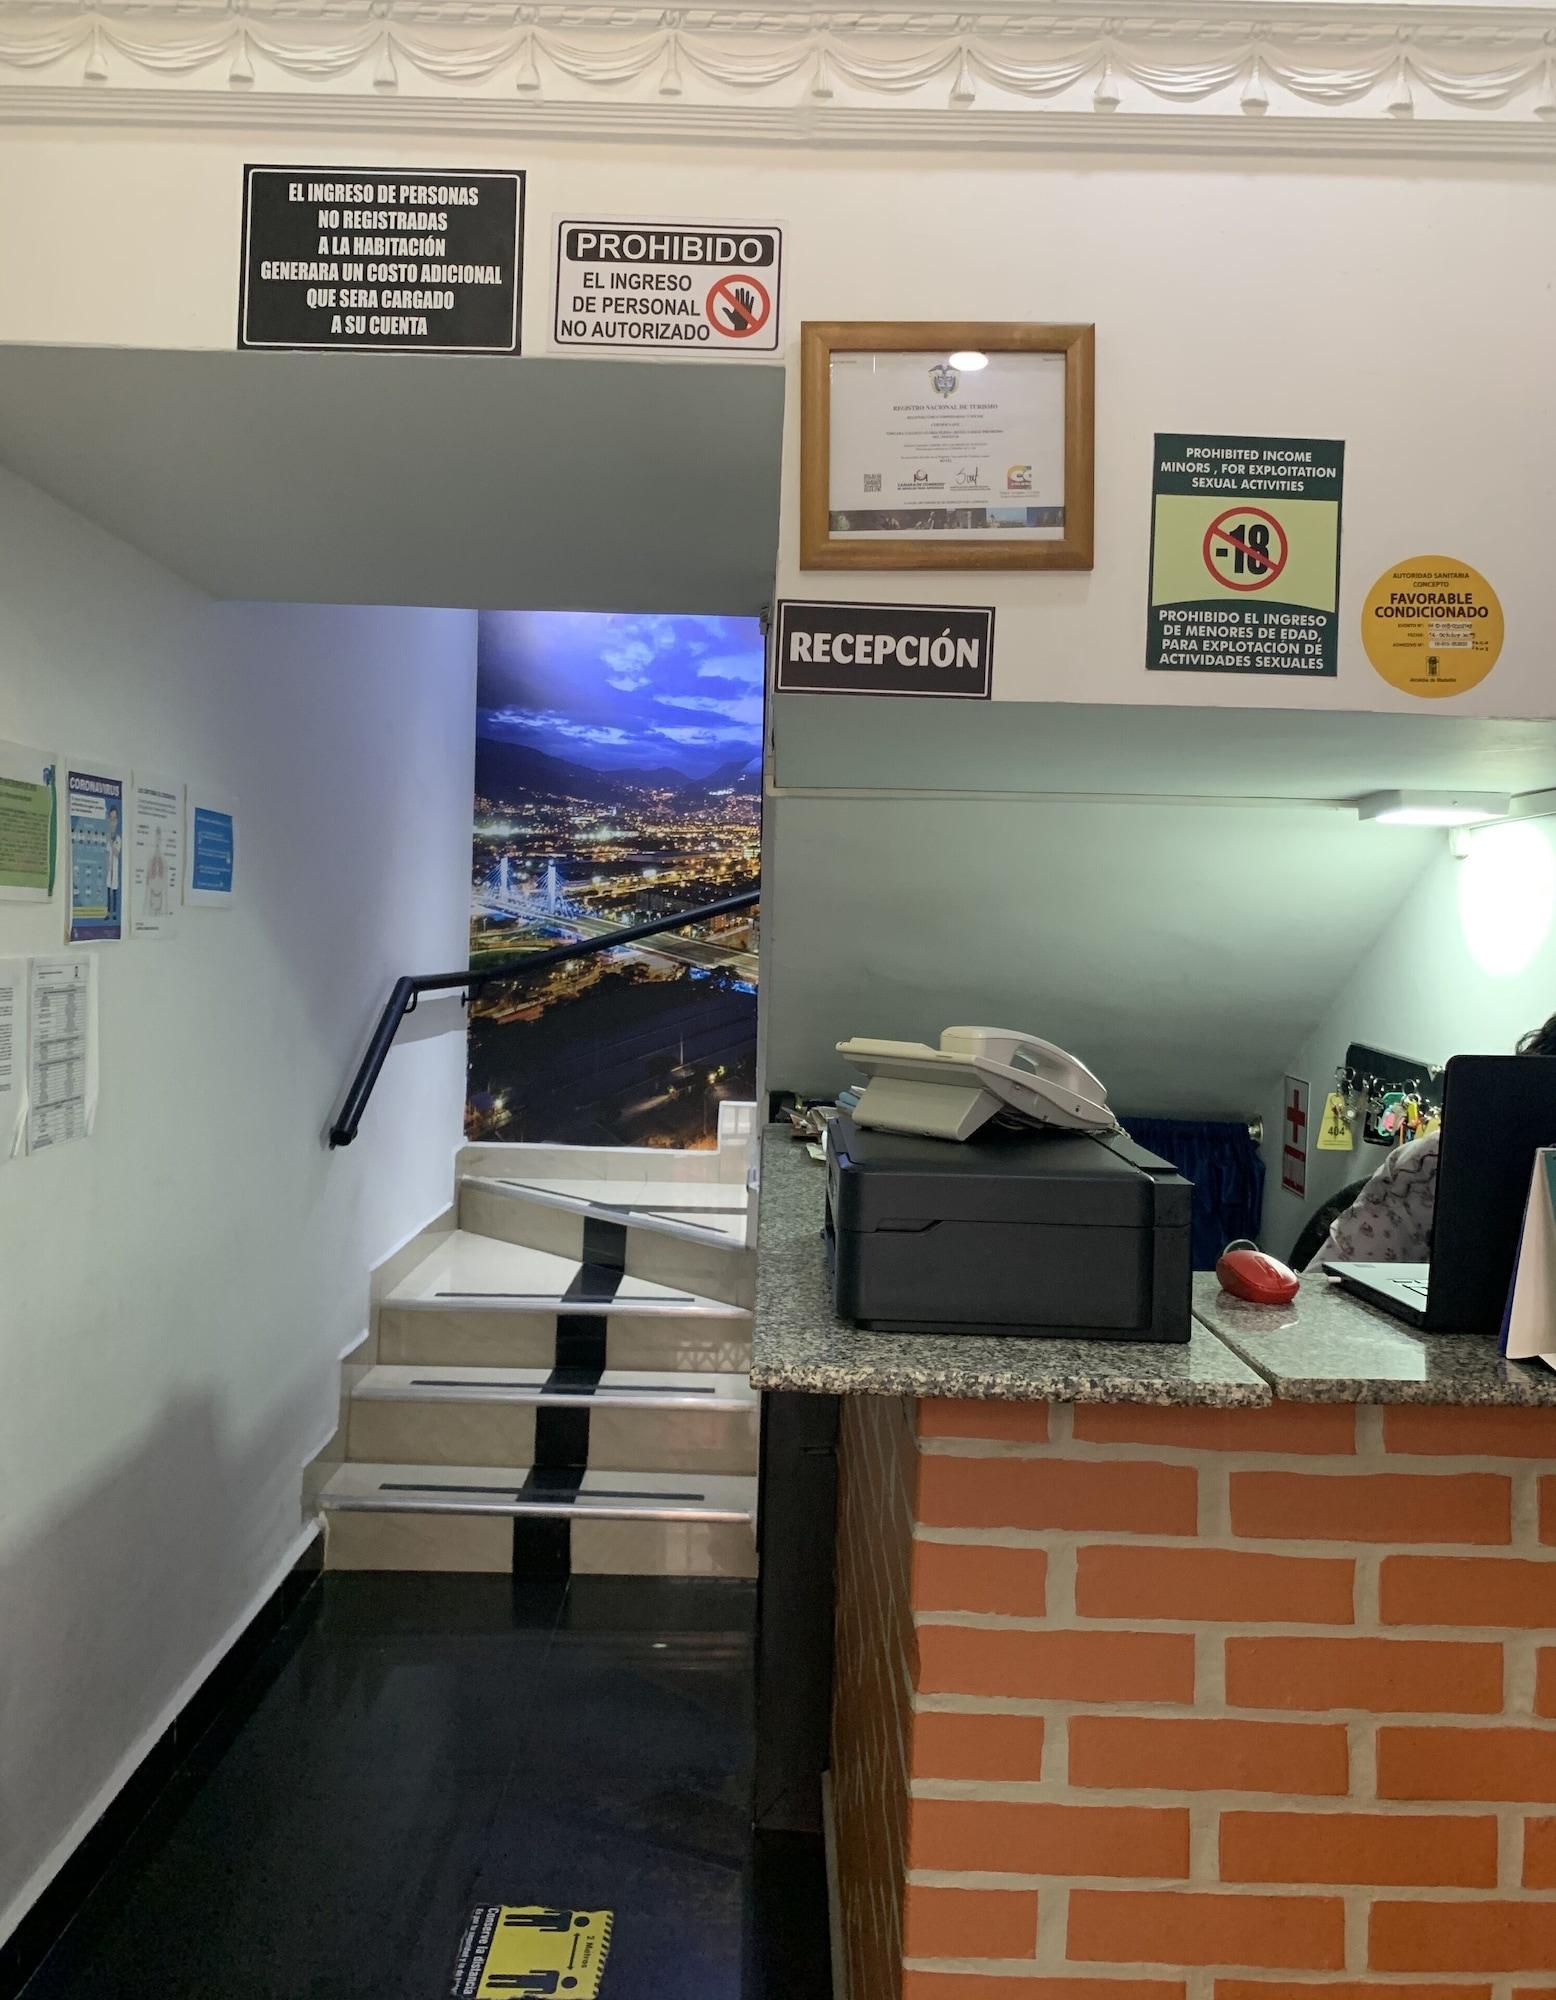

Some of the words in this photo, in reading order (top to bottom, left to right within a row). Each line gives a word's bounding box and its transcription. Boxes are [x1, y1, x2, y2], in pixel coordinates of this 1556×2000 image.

[288, 183, 304, 202] EL
[308, 184, 373, 203] INGRESO
[377, 185, 396, 204] DE
[400, 185, 479, 206] PERSONAS
[318, 210, 339, 229] NO
[343, 210, 448, 231] REGISTRADAS
[318, 236, 328, 255] A
[332, 236, 350, 255] LA
[353, 235, 446, 257] HABITACIÓN
[576, 232, 763, 263] PROHIBIDO
[261, 261, 338, 281] GENERARA
[342, 263, 363, 281] UN
[366, 263, 417, 283] COSTO
[420, 264, 502, 284] ADICIONAL
[583, 272, 605, 289] EL
[611, 273, 692, 291] INGRESO
[306, 288, 336, 309] QUE
[339, 289, 378, 308] SERA
[381, 290, 455, 309] CARGADO
[572, 296, 596, 313] DE
[602, 297, 701, 316] PERSONAL
[331, 315, 342, 334] A
[344, 316, 366, 334] SU
[369, 316, 428, 335] CUENTA
[561, 320, 586, 337] NO
[591, 321, 710, 341] AUTORIZADO
[1186, 448, 1259, 460] PROHIBITED
[1263, 450, 1312, 463] INCOME
[1160, 462, 1210, 473] MINORS
[1221, 464, 1245, 475] FOR
[1249, 465, 1336, 478] EXPLOITATION
[1192, 477, 1237, 489] SEXUAL
[1241, 479, 1304, 492] ACTIVITIES
[1390, 593, 1473, 605] FAVORABLE
[1159, 610, 1240, 624] PROHIBIDO
[1244, 613, 1259, 625] EL
[1263, 613, 1327, 627] INGRESO
[1375, 606, 1488, 618] CONDICIONADO
[1163, 624, 1181, 636] DE
[1185, 625, 1253, 639] MENORES
[1258, 627, 1276, 639] DE
[1280, 628, 1322, 643] EDAD,
[789, 627, 980, 668] RECEPCIÓN
[1162, 638, 1198, 650] PARA
[1202, 639, 1300, 654] EXPLOTACIÓN
[1304, 643, 1322, 655] DE
[1159, 653, 1251, 667] ACTIVIDADES
[1255, 656, 1323, 669] SEXUALES
[70, 777, 120, 796] CORONAVIRUS
[478, 1907, 499, 1944] Conserve
[475, 1945, 488, 1954] la
[463, 1956, 484, 1995] distancia
